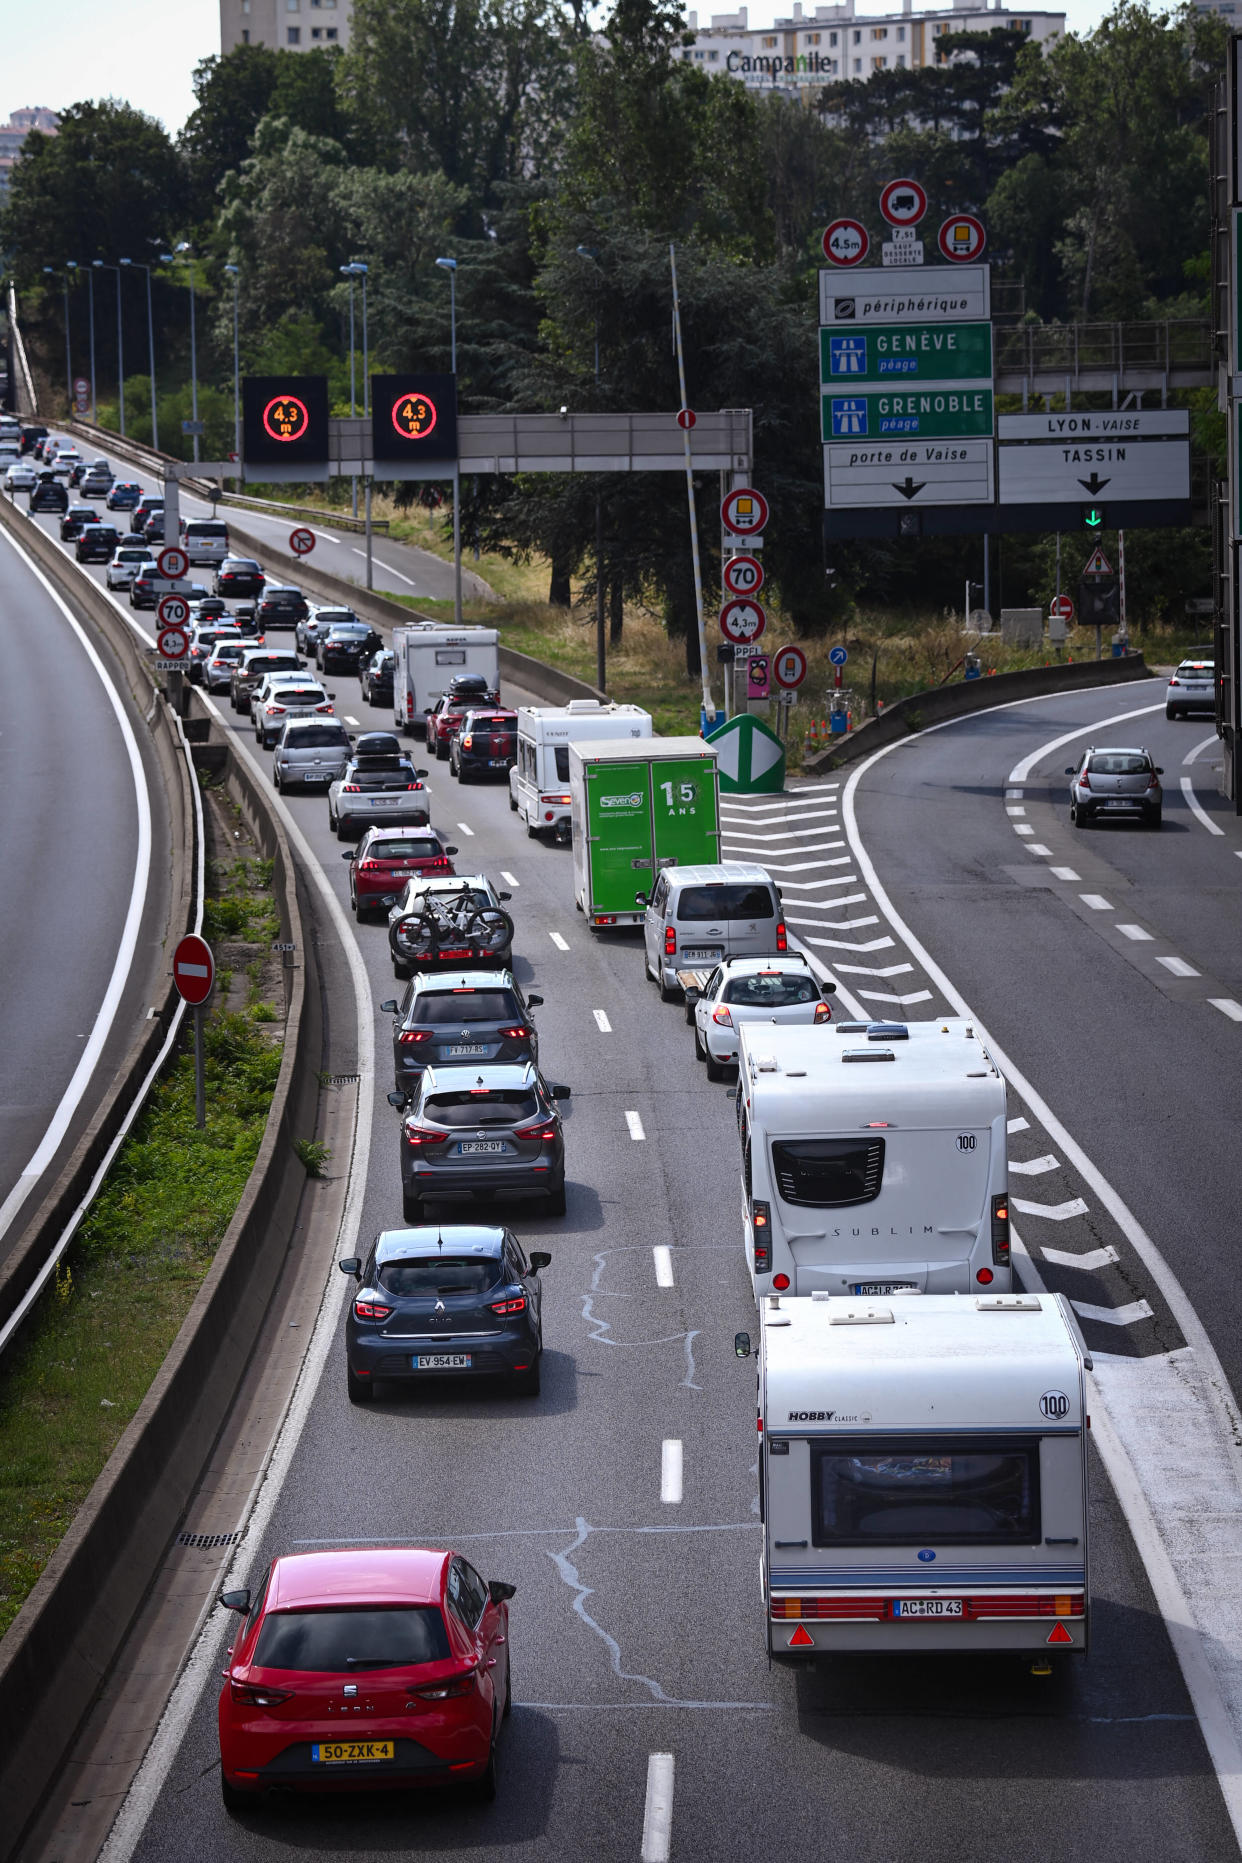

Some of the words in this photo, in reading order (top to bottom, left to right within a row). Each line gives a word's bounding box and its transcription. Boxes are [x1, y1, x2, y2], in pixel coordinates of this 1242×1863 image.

[726, 51, 831, 80] Campanile
[884, 250, 922, 258] DESSERTE
[863, 297, 968, 316] périphérique
[877, 331, 957, 351] GENÈVE
[880, 359, 917, 372] péage
[879, 395, 984, 414] GRENOBLE
[280, 423, 292, 433] m
[408, 421, 420, 431] m
[881, 417, 918, 430] péage
[850, 451, 892, 466] porte
[900, 449, 917, 461] de
[926, 448, 967, 460] Vaise
[1062, 448, 1126, 463] TASSIN
[732, 568, 755, 585] 70
[165, 605, 184, 619] 70
[660, 781, 694, 806] 15
[669, 807, 696, 815] ANS
[957, 1135, 976, 1150] 100
[832, 1225, 933, 1237] SUBLIM
[1042, 1396, 1067, 1416] 100
[788, 1411, 835, 1421] HOBBY
[901, 1601, 918, 1614] AC
[926, 1601, 943, 1614] RD
[945, 1600, 962, 1613] 43
[325, 1744, 388, 1758] 50-ZXK-4
